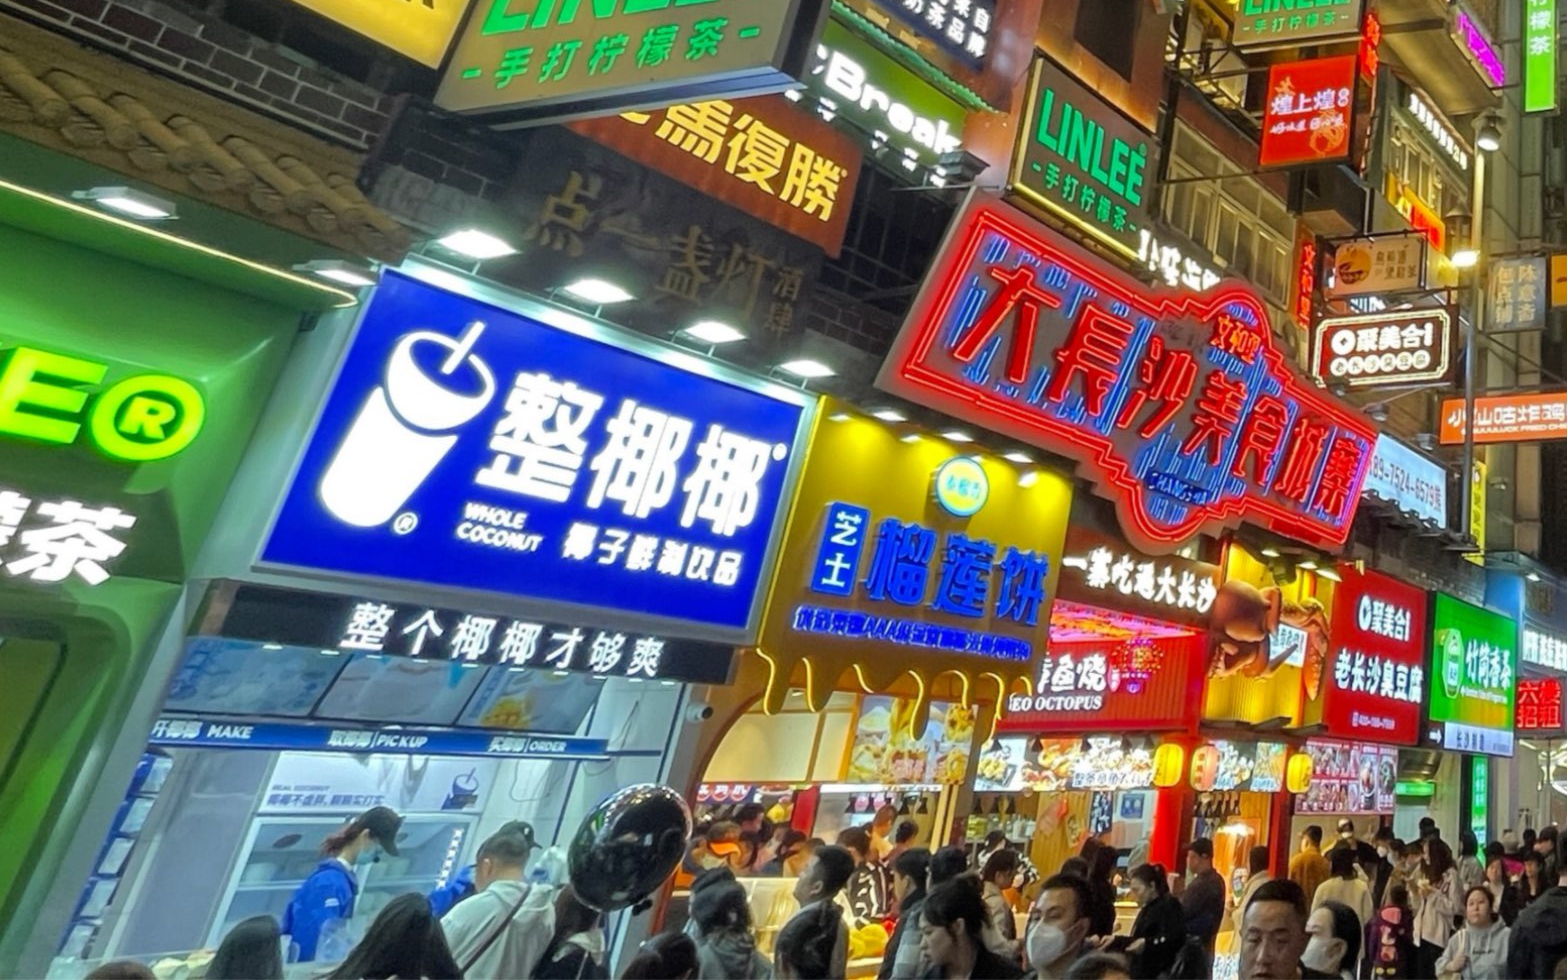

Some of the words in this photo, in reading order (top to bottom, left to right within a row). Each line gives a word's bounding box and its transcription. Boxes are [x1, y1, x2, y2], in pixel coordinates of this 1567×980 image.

[494, 18, 730, 90] 手打柠檬茶
[822, 56, 962, 156] Break
[1271, 87, 1334, 116] 煌上煌
[1037, 86, 1147, 208] LINLEE
[1045, 161, 1130, 235] 手打柠檬茶
[1356, 323, 1424, 353] 聚美合
[474, 371, 772, 536] 整椰椰
[456, 522, 544, 552] COCONUT
[463, 502, 527, 530] WHOLE
[819, 510, 864, 588] 芝士
[863, 517, 1050, 628] 榴莲饼
[341, 601, 667, 678] 整个椰椰才够爽
[1034, 694, 1103, 712] OCTOPUS
[1334, 647, 1425, 704] 老长沙臭豆腐
[206, 725, 254, 739] MAKE
[1517, 704, 1561, 729] 招租
[529, 740, 568, 752] ORDER
